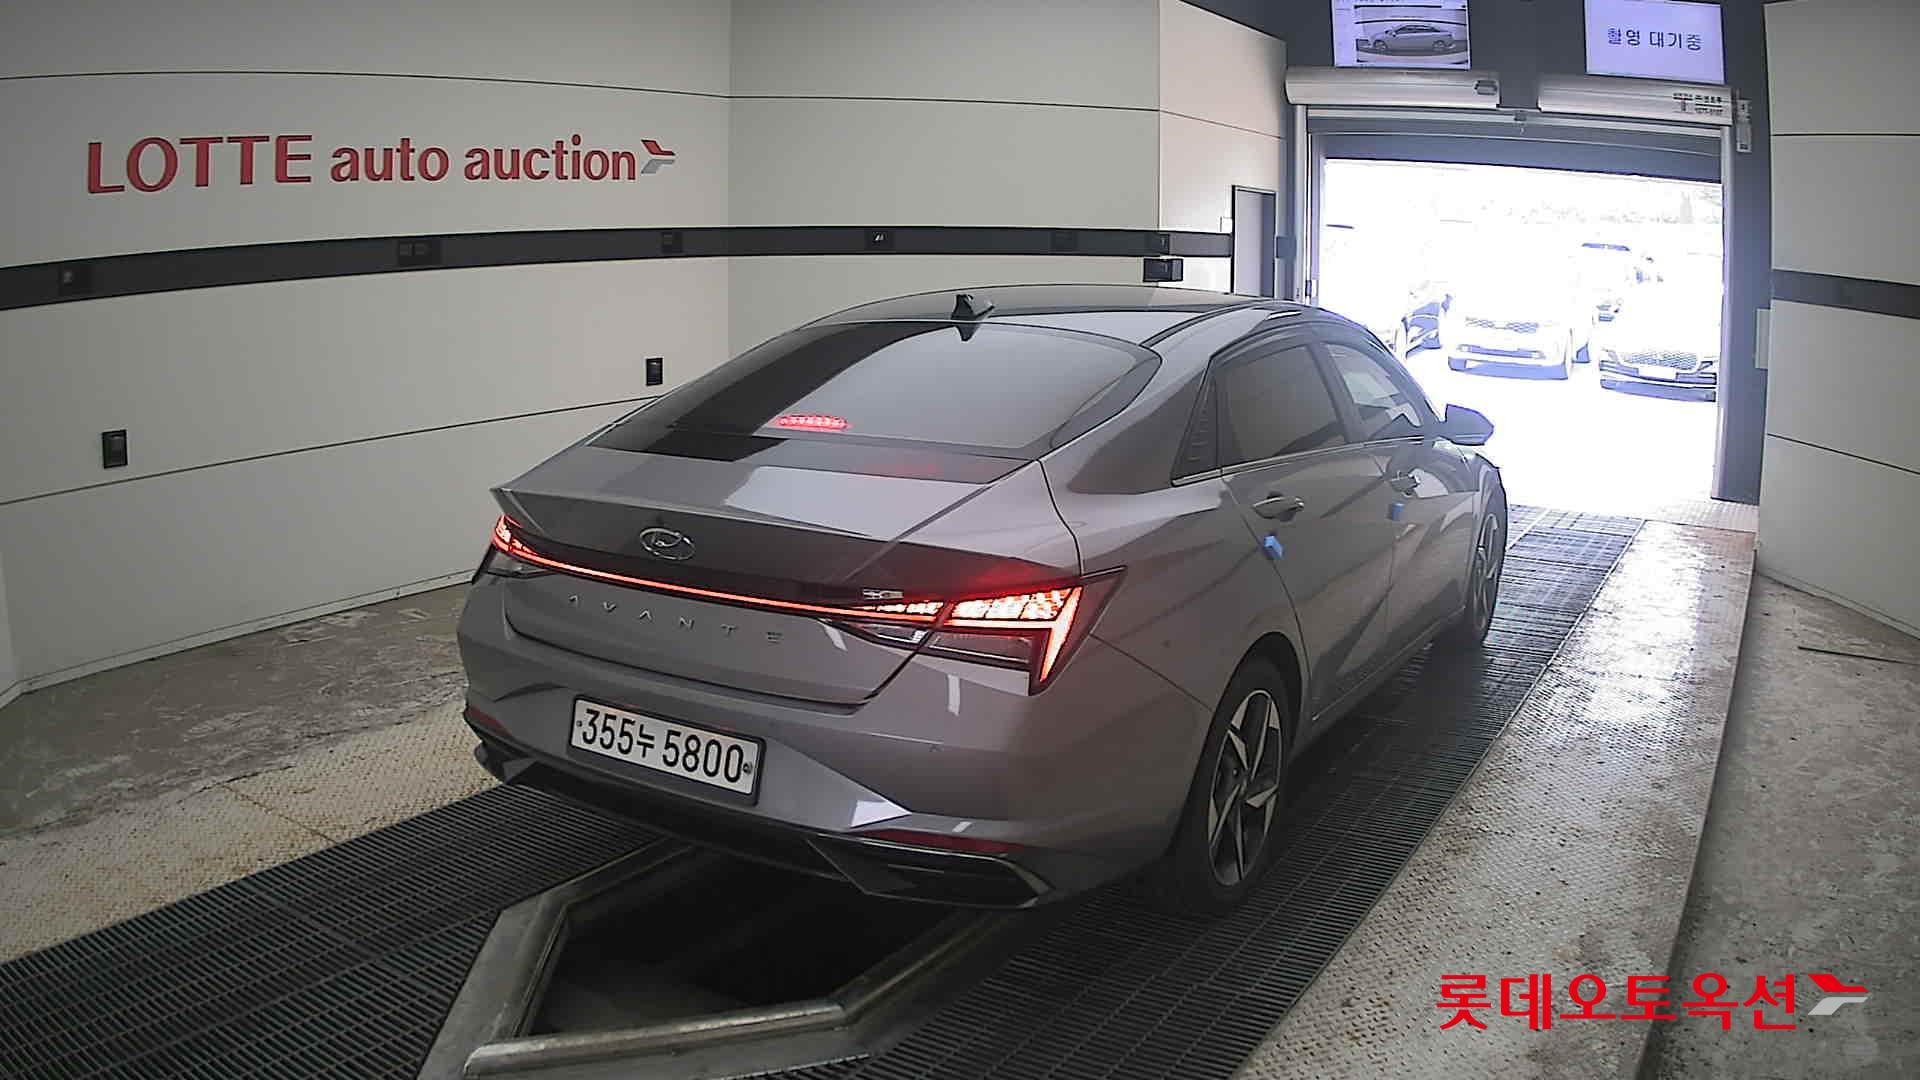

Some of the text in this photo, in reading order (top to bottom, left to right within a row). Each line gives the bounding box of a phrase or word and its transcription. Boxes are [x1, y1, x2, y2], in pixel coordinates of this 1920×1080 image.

[1649, 30, 1702, 51] 대기중
[87, 133, 638, 194] LOTTE auto auction
[567, 593, 784, 643] AVANTE
[582, 708, 745, 783] 355누 5800
